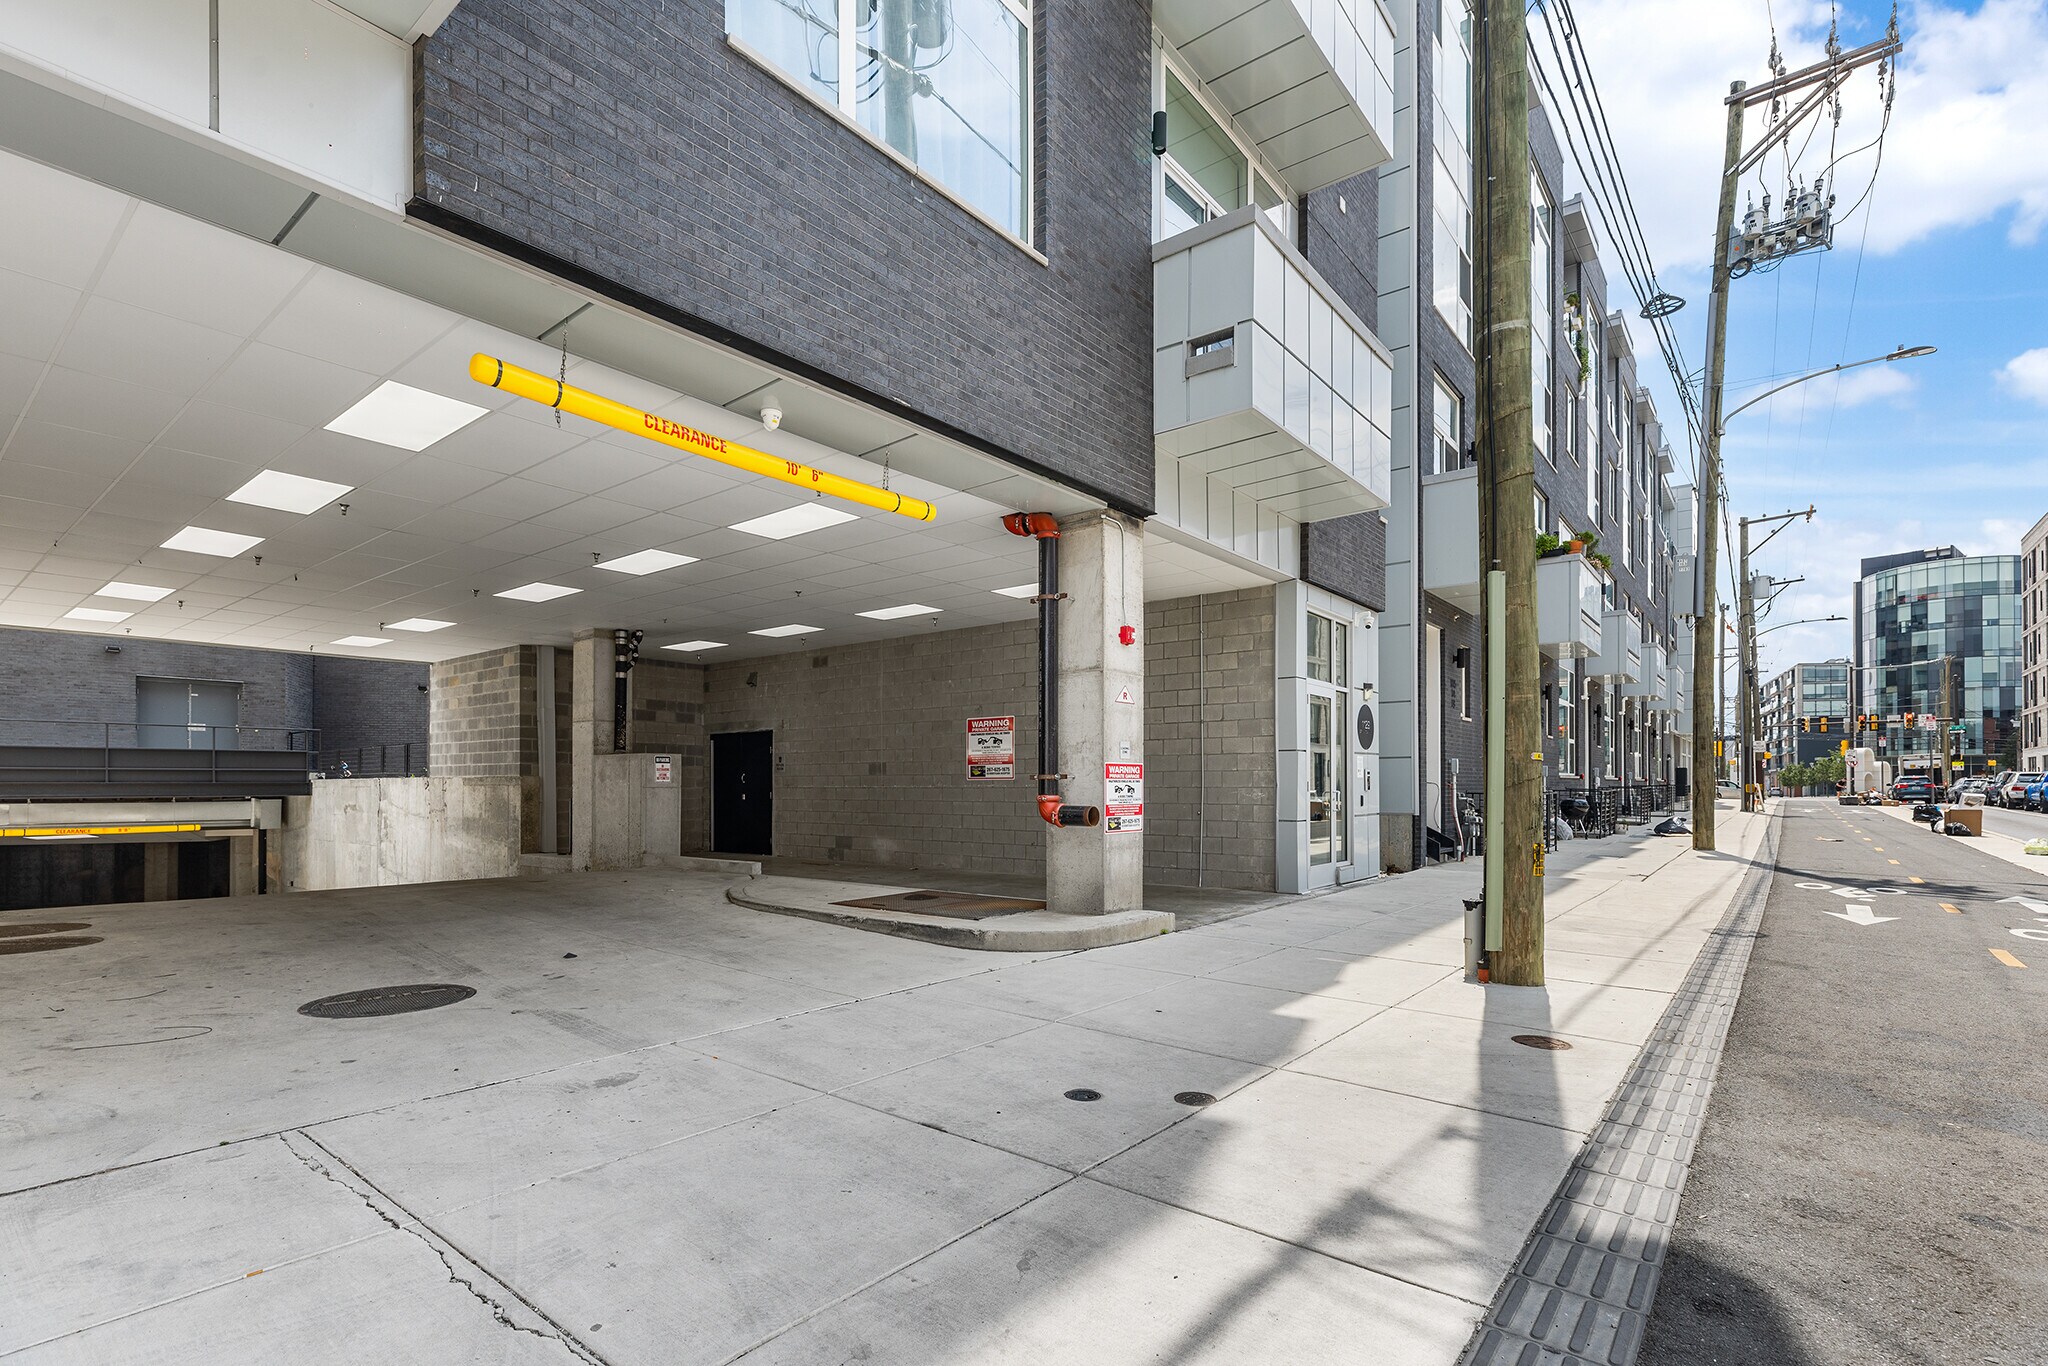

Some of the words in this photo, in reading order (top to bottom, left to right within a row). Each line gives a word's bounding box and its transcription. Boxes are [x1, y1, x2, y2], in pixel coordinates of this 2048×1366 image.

[644, 413, 727, 454] CLEARANCE
[786, 461, 801, 476] 10'
[812, 469, 824, 482] 6"
[1123, 692, 1128, 700] R
[972, 719, 1009, 728] WARNING
[1109, 766, 1140, 774] WARNING
